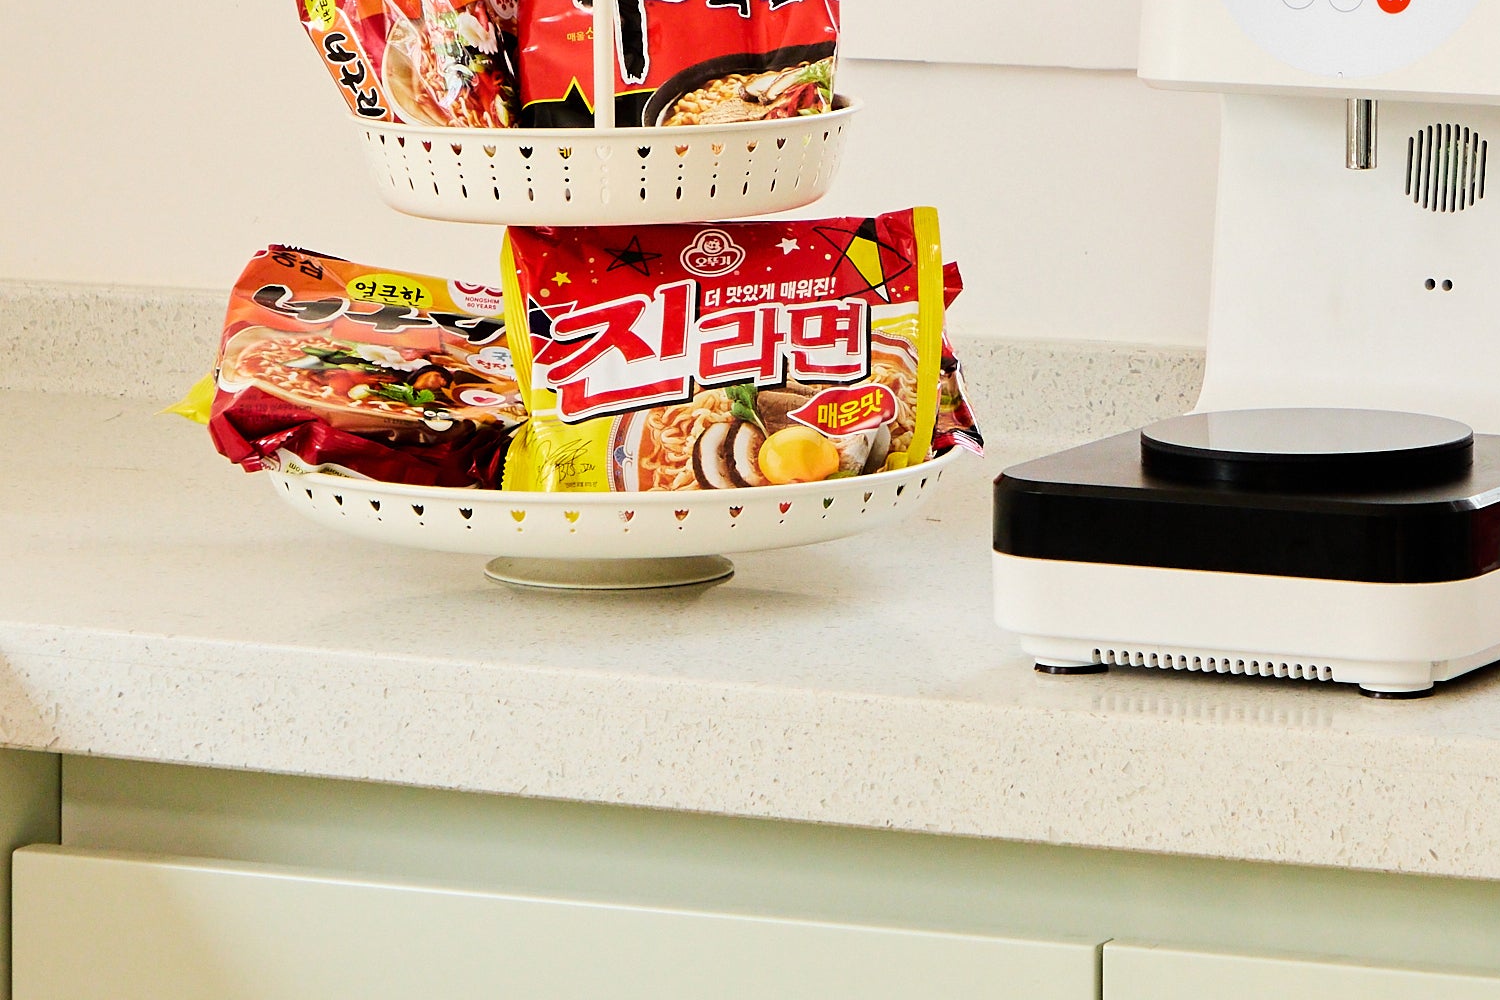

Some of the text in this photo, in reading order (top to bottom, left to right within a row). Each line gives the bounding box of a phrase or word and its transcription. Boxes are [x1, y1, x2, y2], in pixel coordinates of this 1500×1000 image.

[694, 254, 733, 268] 오뚜기
[465, 296, 500, 305] NONGSHIM
[705, 276, 837, 307] 더 맛있게 매워진!
[816, 388, 884, 430] 매운맛
